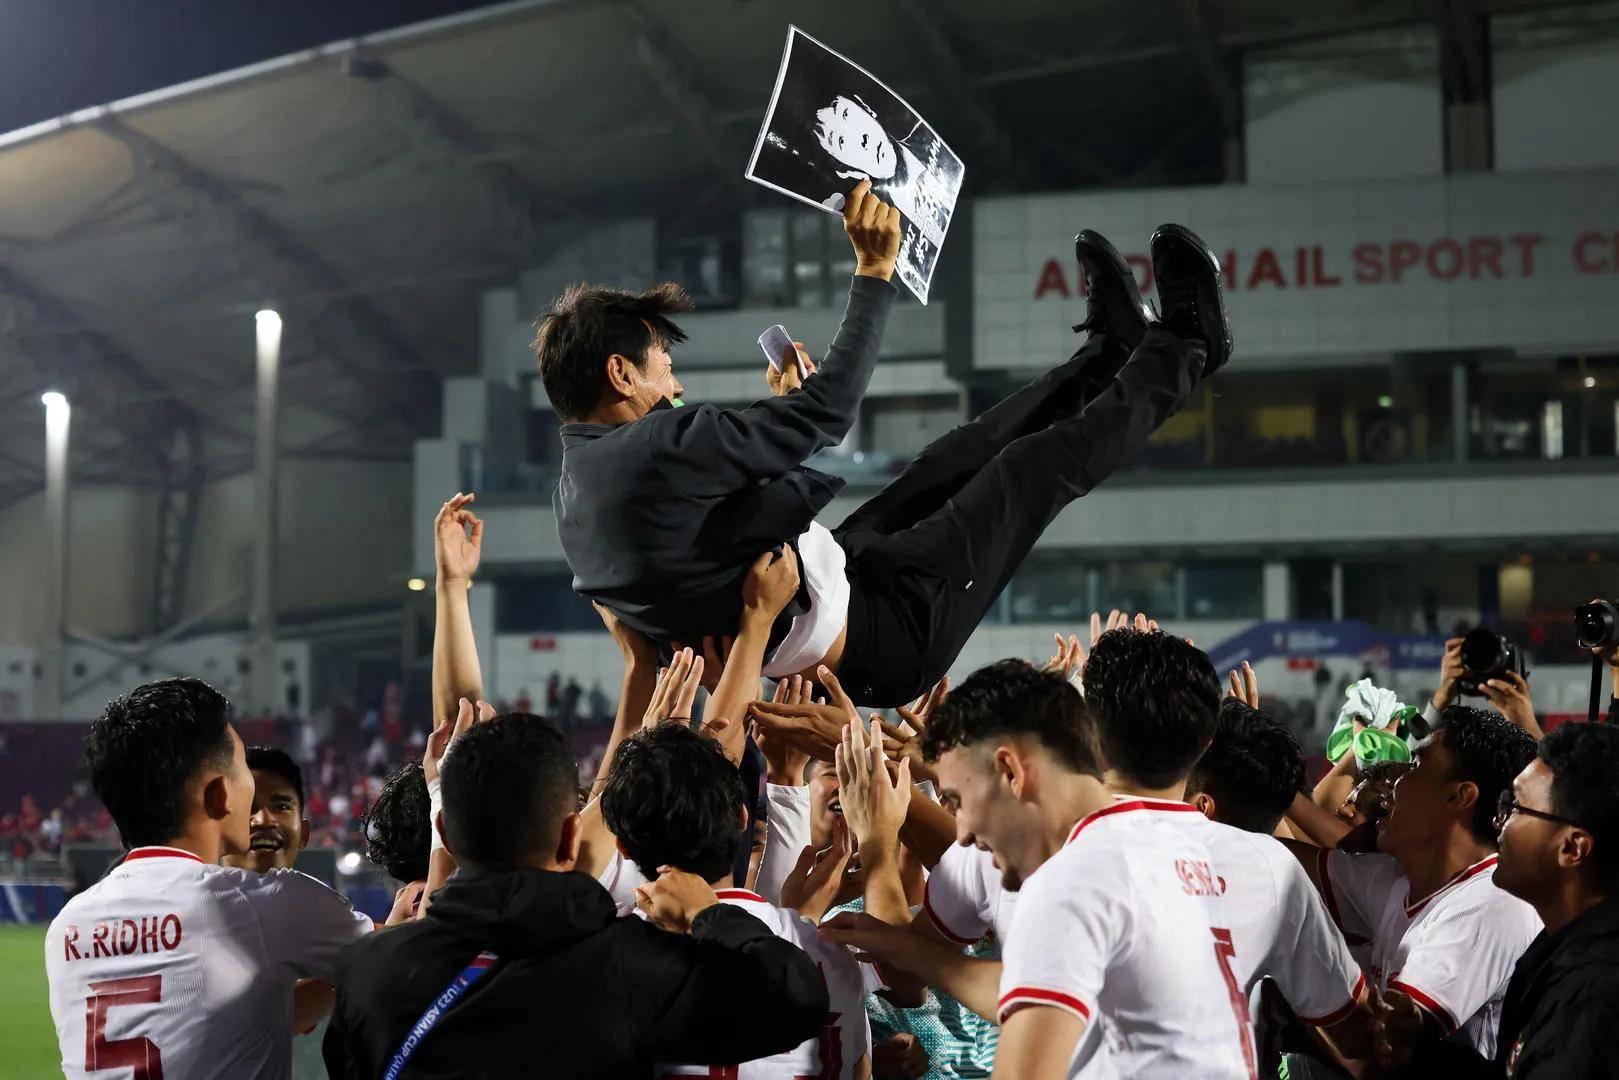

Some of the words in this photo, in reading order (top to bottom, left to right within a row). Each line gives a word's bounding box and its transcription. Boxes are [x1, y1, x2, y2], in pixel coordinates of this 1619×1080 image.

[1353, 232, 1546, 285] SPORT
[64, 913, 182, 961] R.RIDHO
[85, 974, 164, 1080] 5
[413, 1004, 440, 1038] ASIAN
[402, 1035, 417, 1057] CUP
